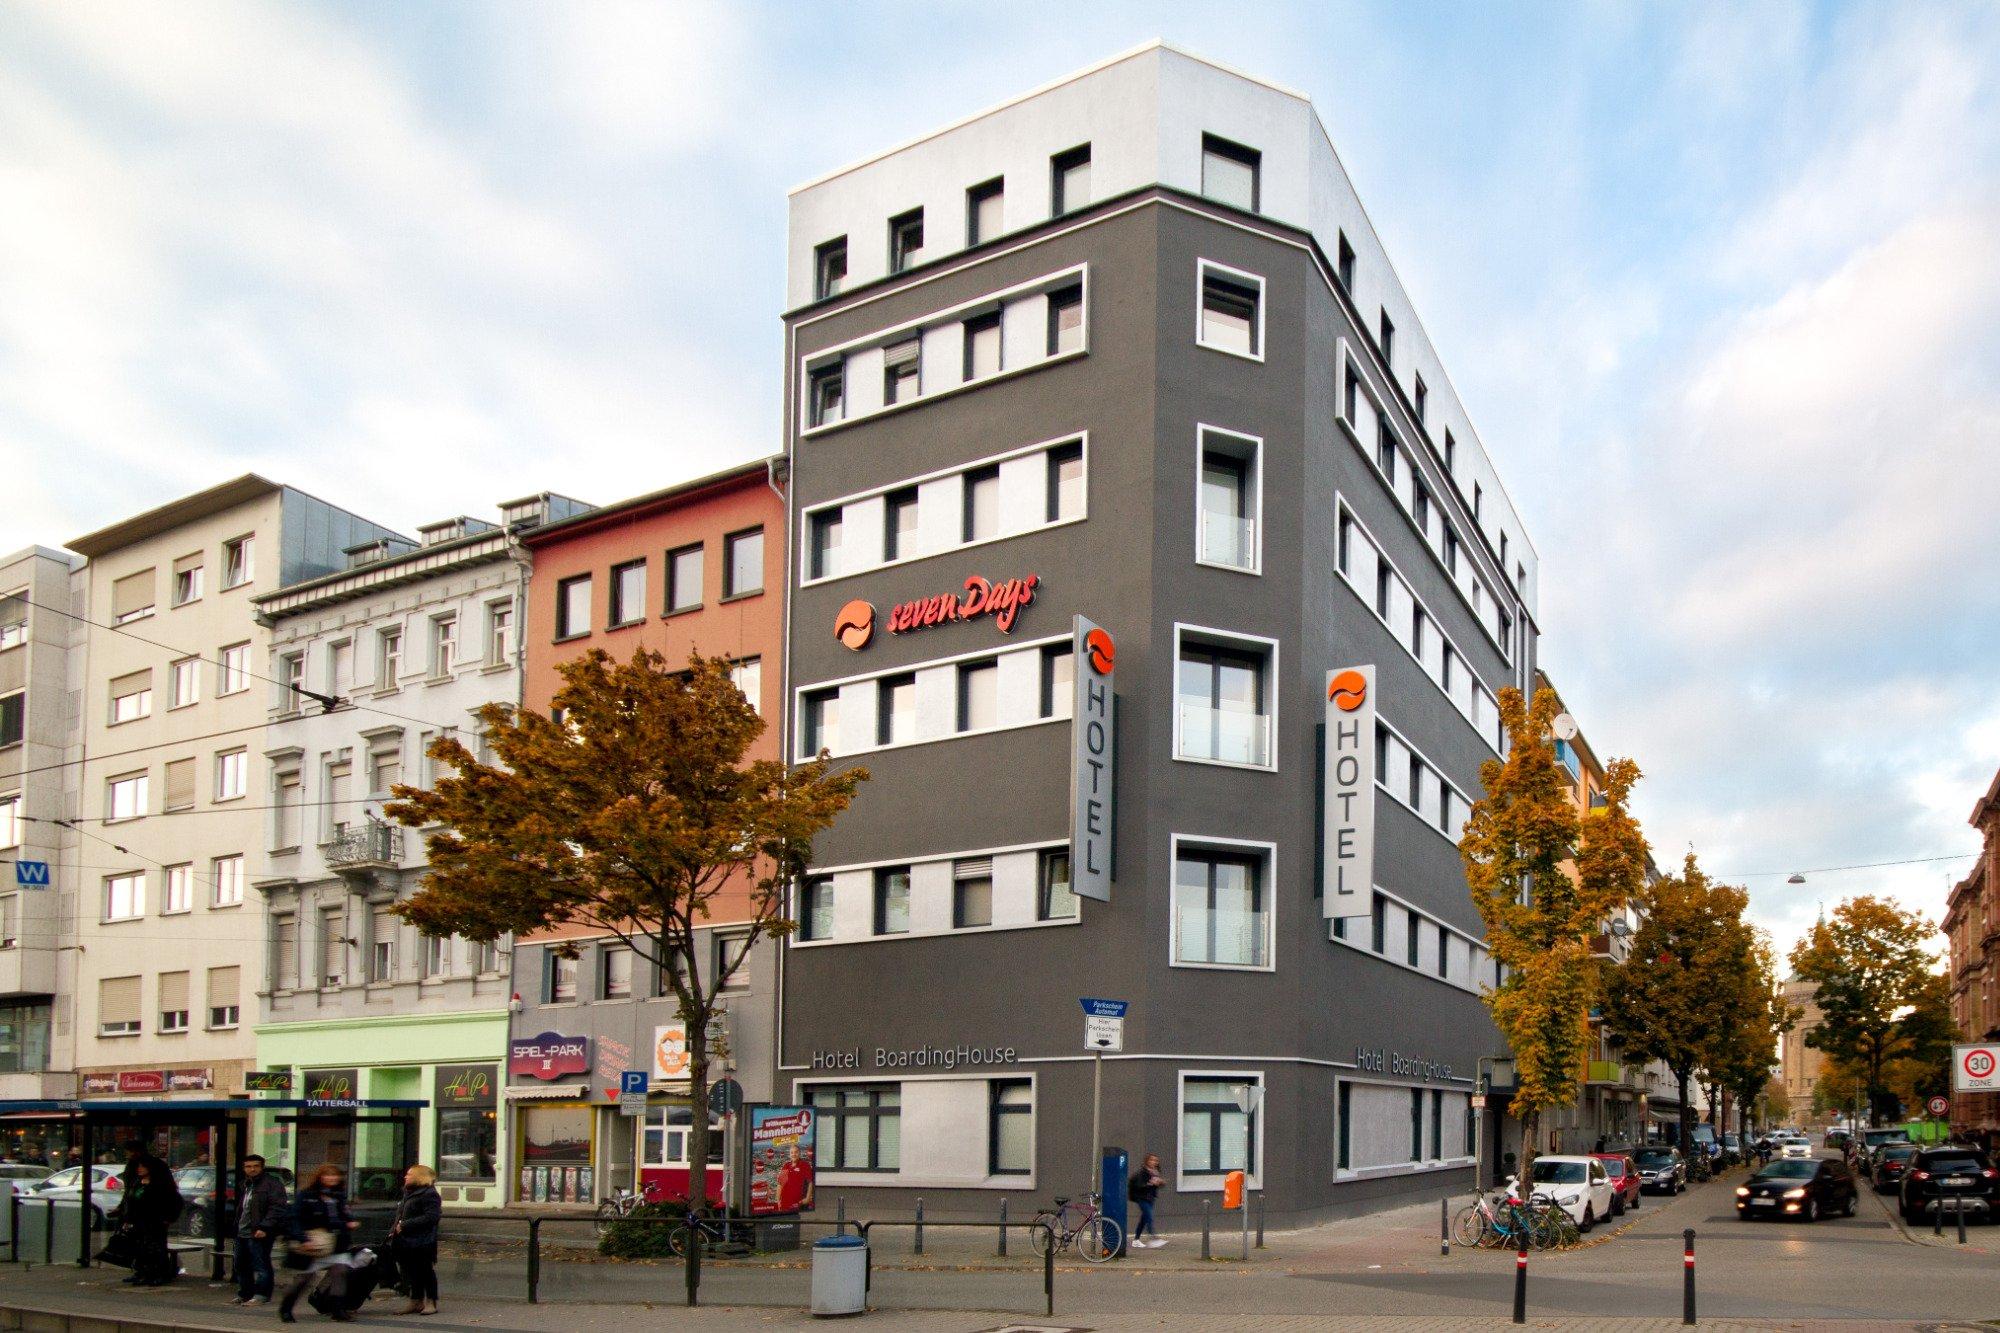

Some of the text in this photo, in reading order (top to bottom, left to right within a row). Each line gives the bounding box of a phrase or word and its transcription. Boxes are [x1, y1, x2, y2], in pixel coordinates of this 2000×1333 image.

[1086, 678, 1105, 875] HOTEL
[1336, 718, 1359, 896] HOTEL
[18, 863, 46, 882] W
[1092, 1001, 1123, 1010] Parkschein
[1094, 1008, 1119, 1016] Automat
[812, 1045, 1016, 1069] Hotel BoardingHouse
[1356, 1047, 1452, 1081] Hotel BoardingHouse
[1971, 1057, 1989, 1071] 30
[626, 1073, 642, 1092] P
[306, 1099, 369, 1108] TATTERSALL
[754, 1124, 804, 1139] Mannheim
